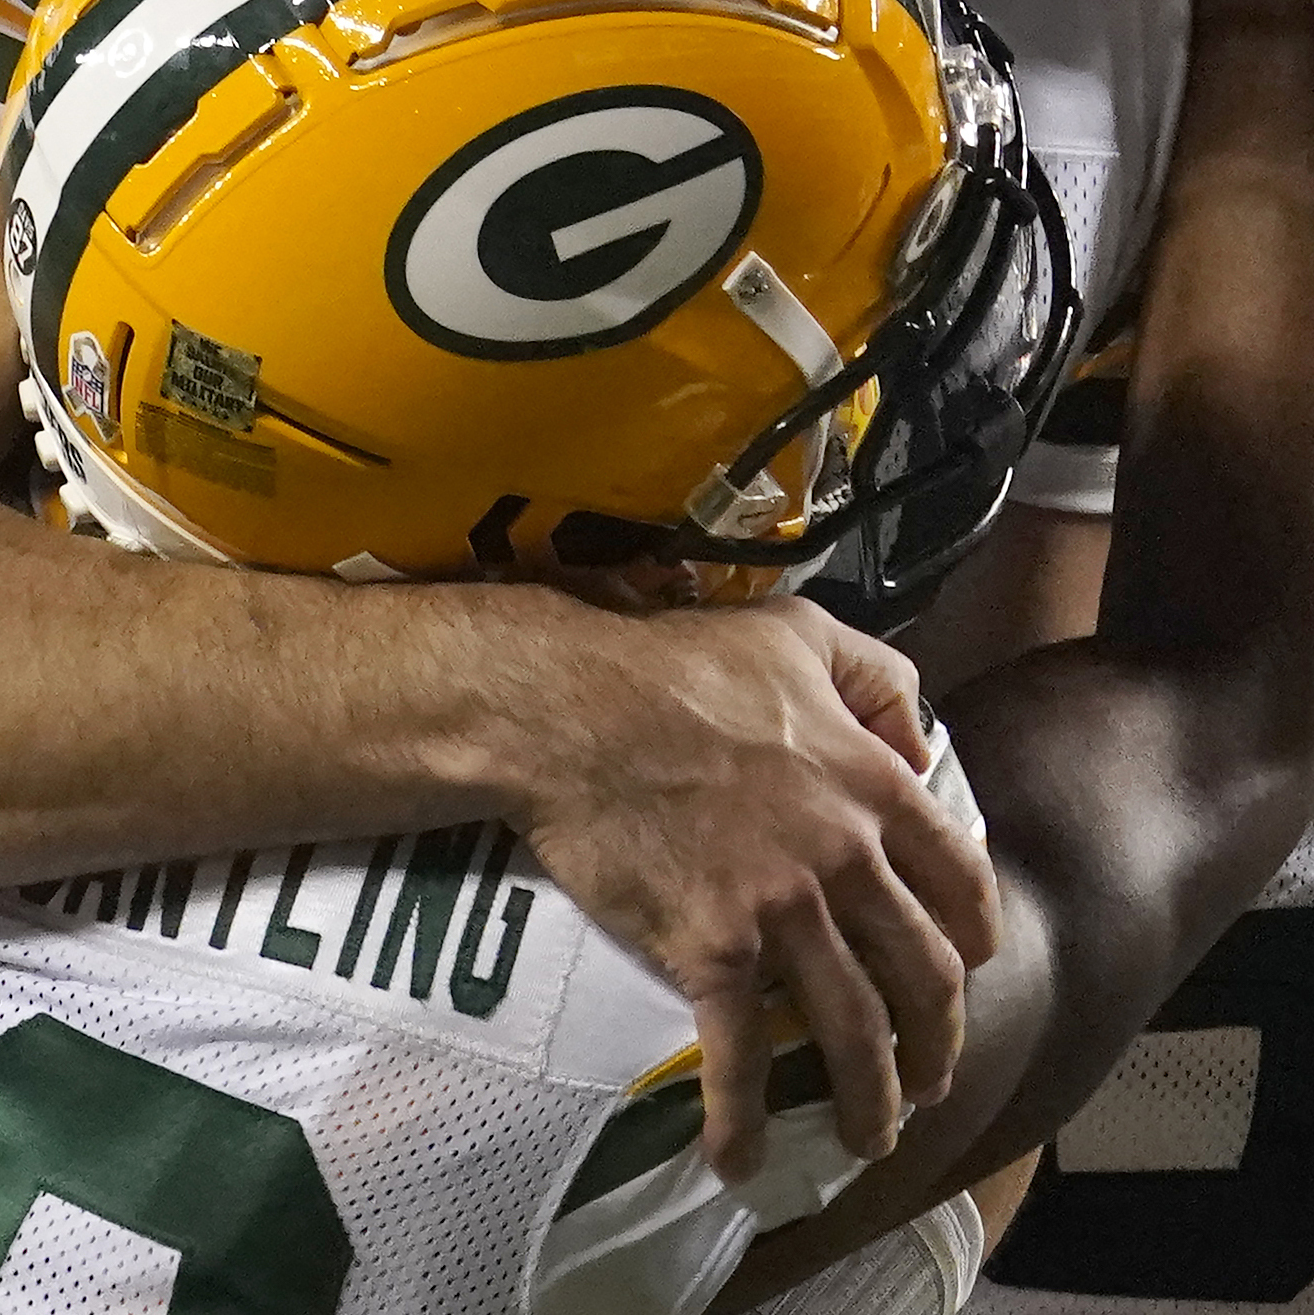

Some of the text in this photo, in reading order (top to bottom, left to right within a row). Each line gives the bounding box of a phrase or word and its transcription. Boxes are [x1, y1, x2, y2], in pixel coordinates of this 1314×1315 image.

[406, 106, 746, 342] G
[72, 376, 102, 411] NFL
[17, 818, 535, 1020] LING
